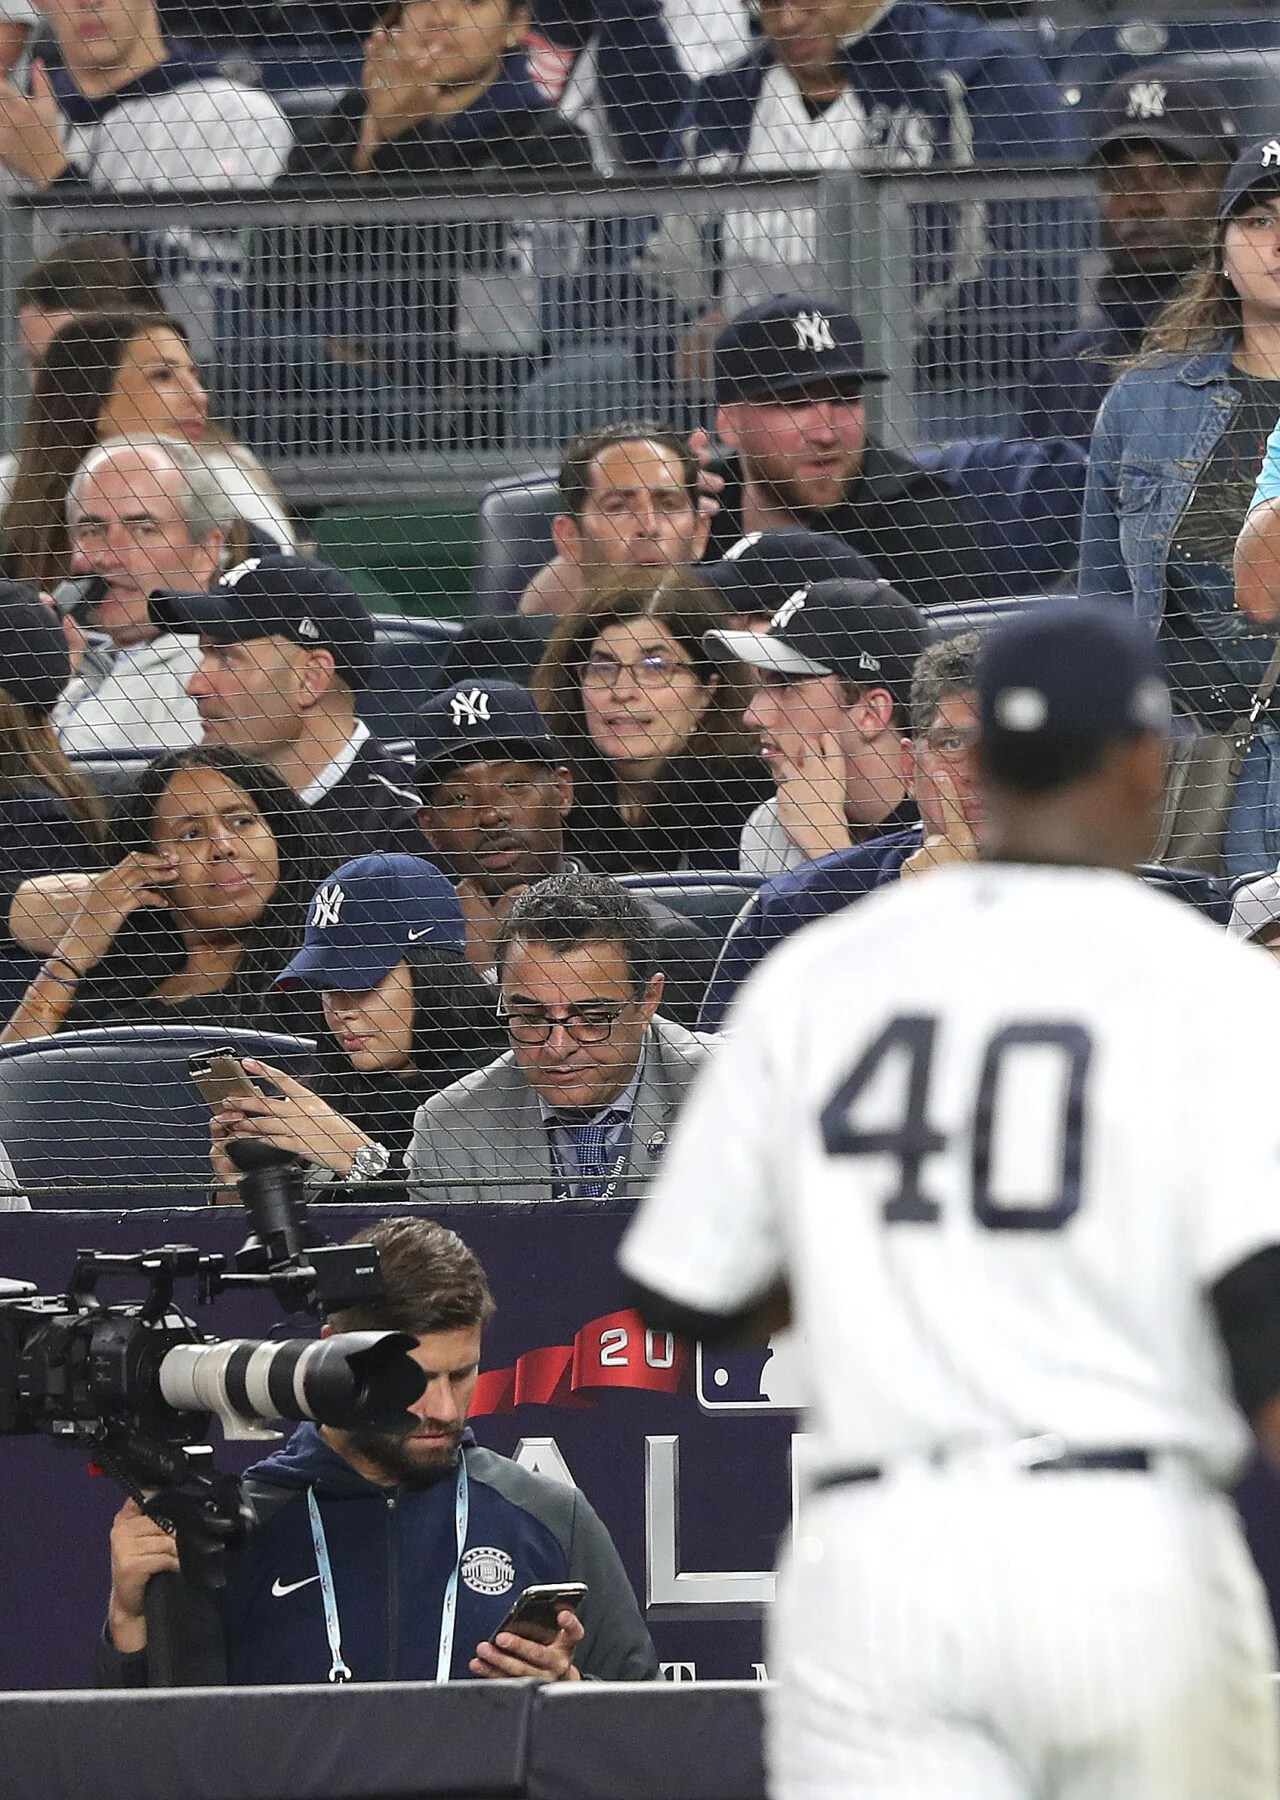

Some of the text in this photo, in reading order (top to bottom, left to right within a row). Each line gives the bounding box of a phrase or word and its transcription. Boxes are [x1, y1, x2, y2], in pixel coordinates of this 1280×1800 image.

[796, 310, 836, 352] NY
[450, 687, 491, 726] NY
[310, 884, 345, 929] NY
[819, 1011, 1096, 1231] 40
[601, 1155, 626, 1201] Preium
[600, 1327, 675, 1369] 20
